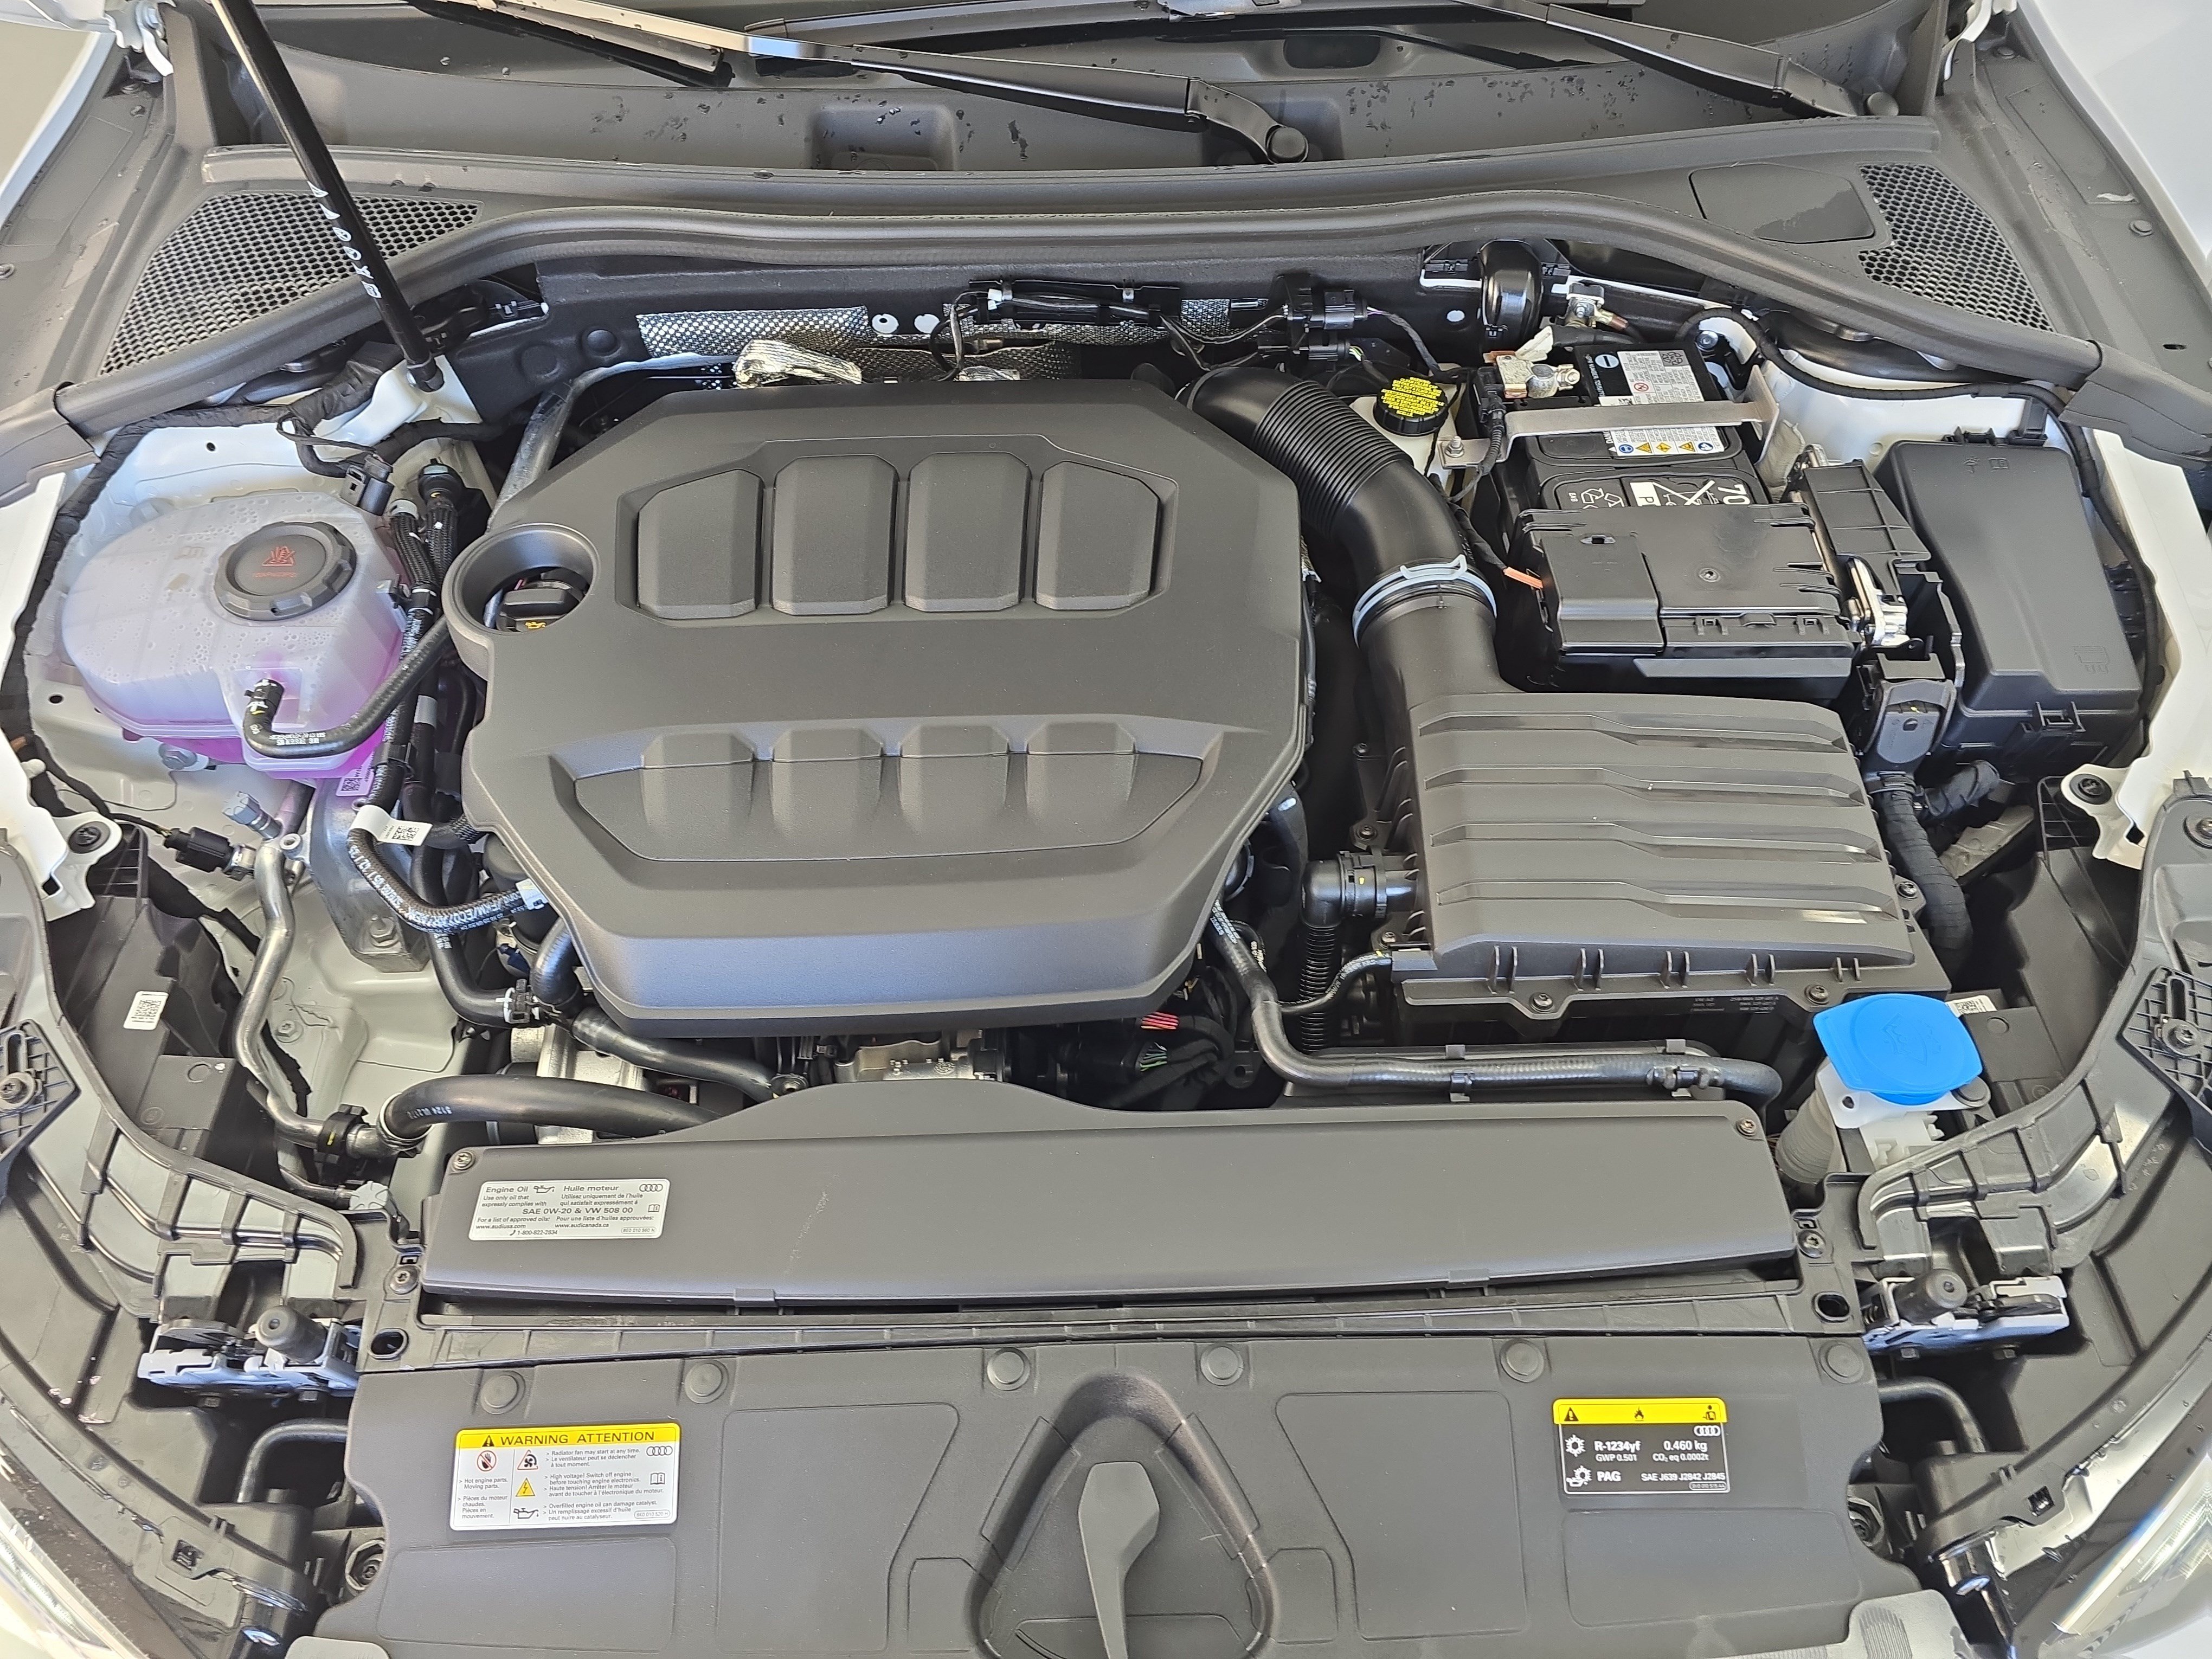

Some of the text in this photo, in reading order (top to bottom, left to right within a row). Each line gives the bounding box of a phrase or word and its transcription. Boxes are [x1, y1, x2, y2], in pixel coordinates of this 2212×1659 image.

[500, 1431, 654, 1445] WARNING ATTENTION
[1594, 1441, 1641, 1453] R-1234yf
[1663, 1439, 1707, 1452] 0.460 kg
[1595, 1454, 1616, 1462] GWP
[1597, 1470, 1621, 1482] PAG
[1641, 1472, 1658, 1481] SAE
[1659, 1472, 1678, 1481] J639
